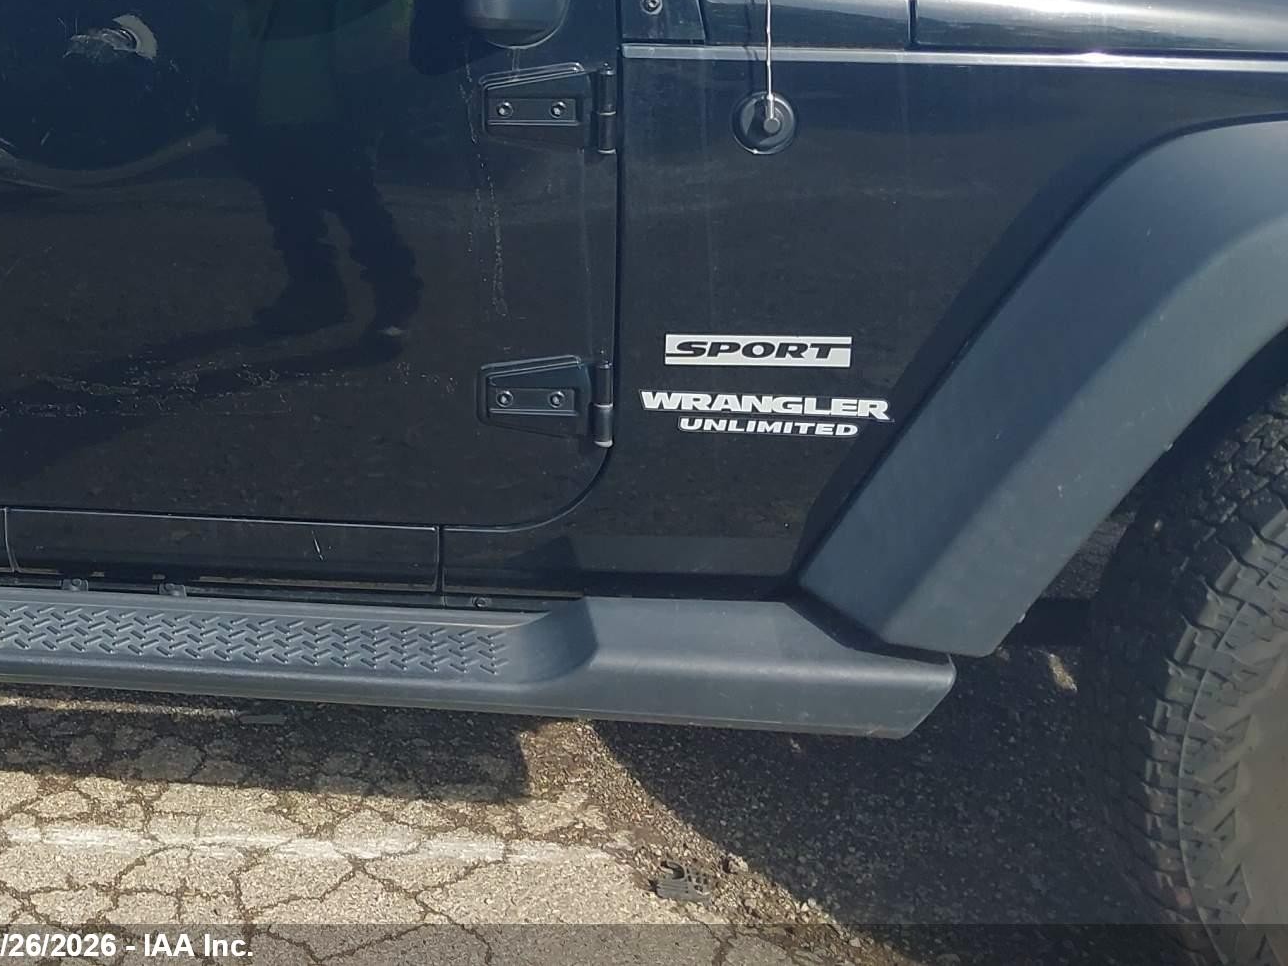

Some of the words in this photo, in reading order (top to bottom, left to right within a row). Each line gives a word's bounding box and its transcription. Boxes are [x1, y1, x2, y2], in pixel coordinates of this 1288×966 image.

[673, 340, 845, 360] SPORT
[640, 390, 891, 421] WRANGLER
[679, 417, 859, 436] UNLIMITED
